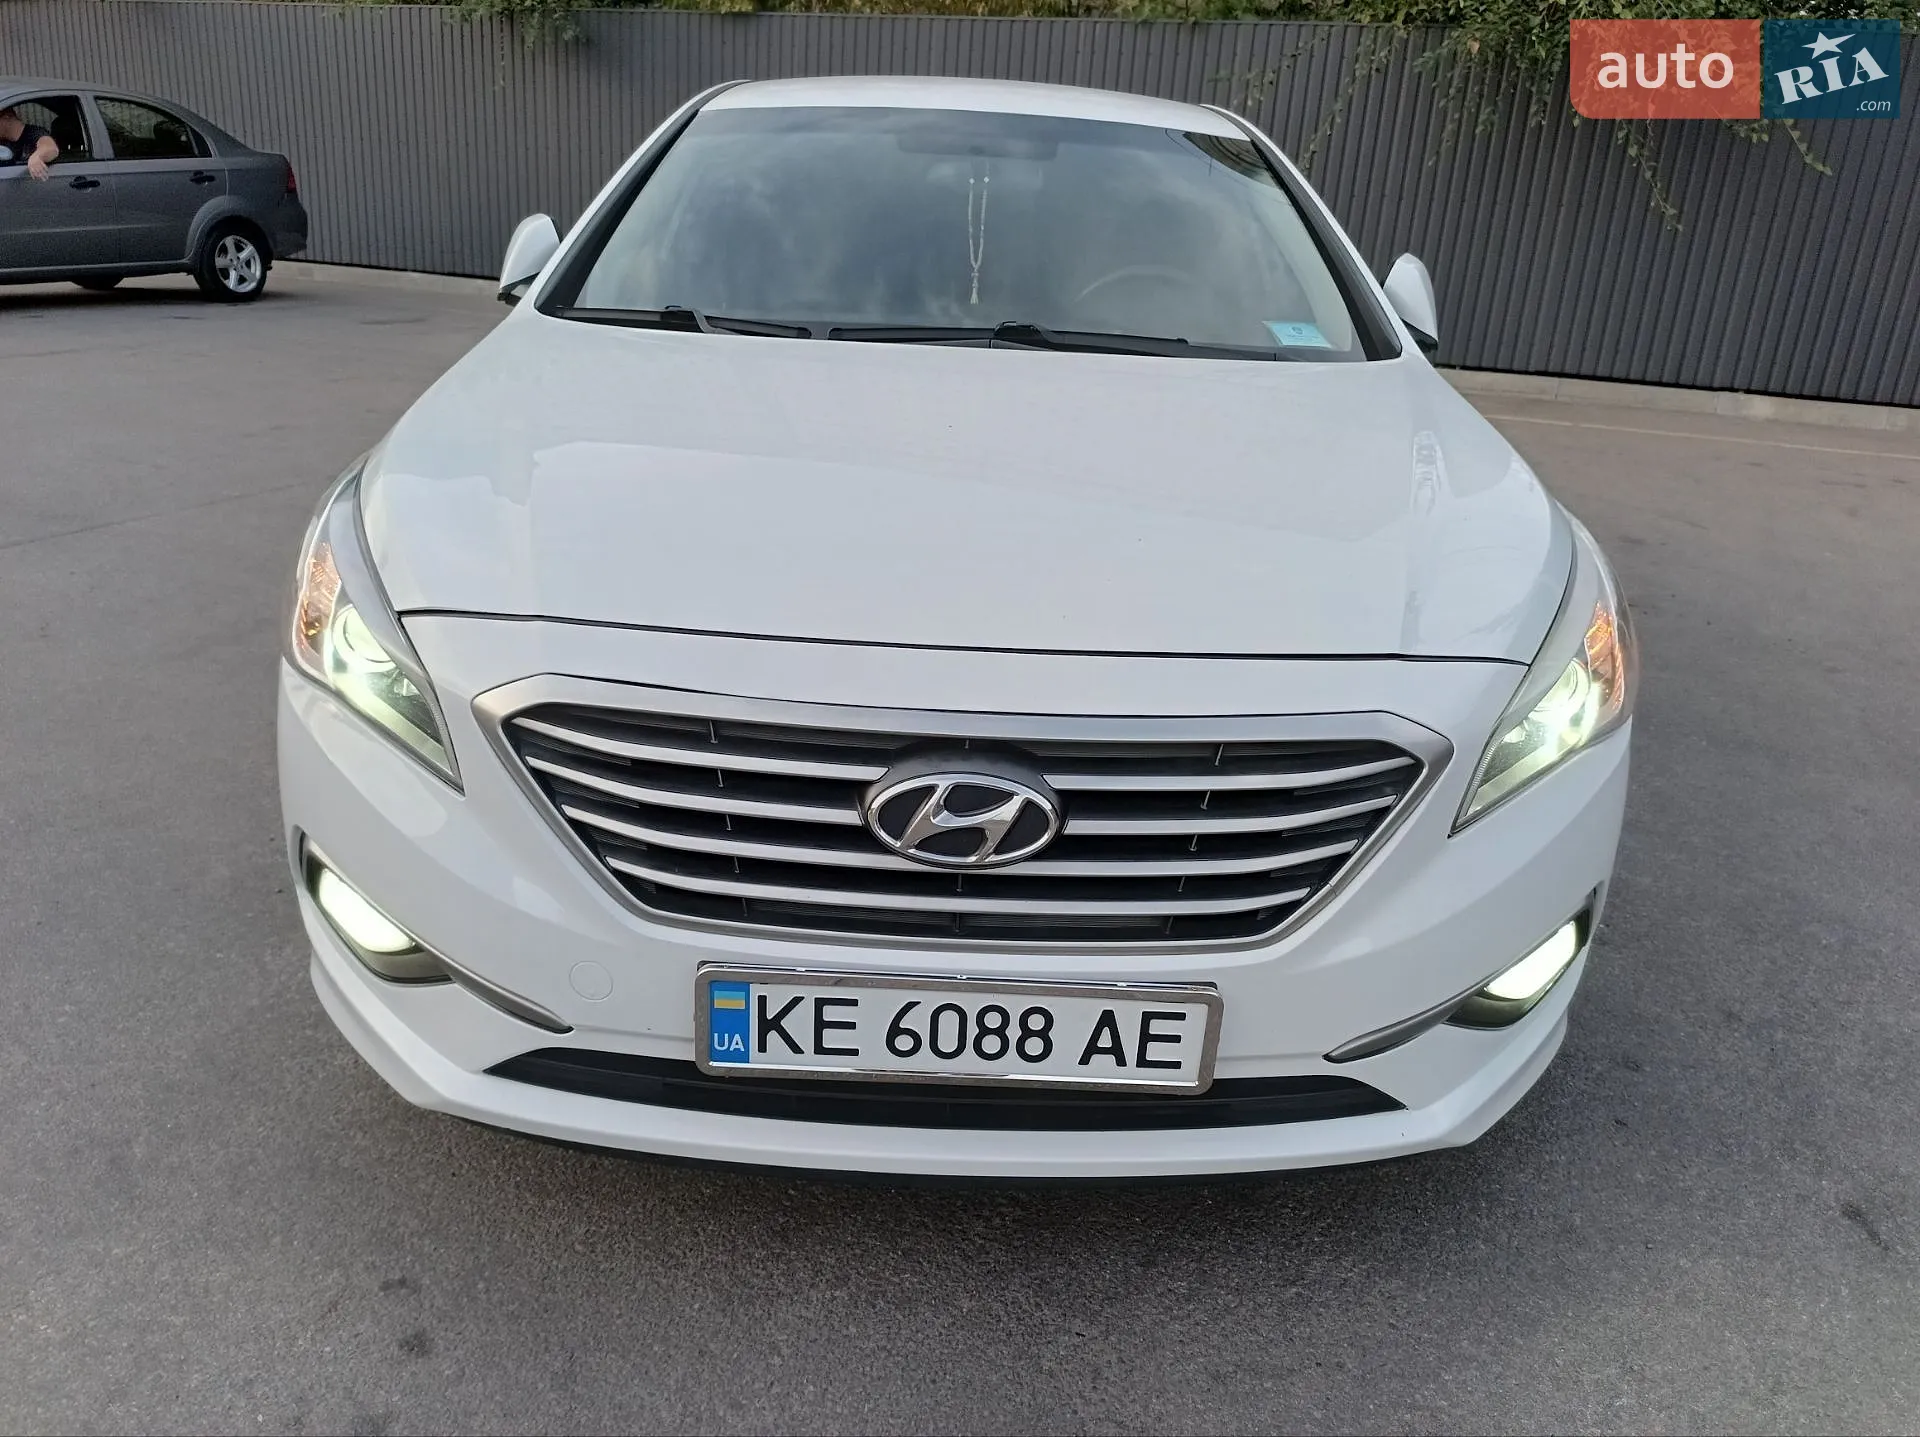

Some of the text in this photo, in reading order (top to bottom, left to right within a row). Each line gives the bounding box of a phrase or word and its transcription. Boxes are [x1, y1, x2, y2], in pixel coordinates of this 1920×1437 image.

[714, 1034, 745, 1053] UA
[757, 994, 1187, 1070] KE 6088 AE
